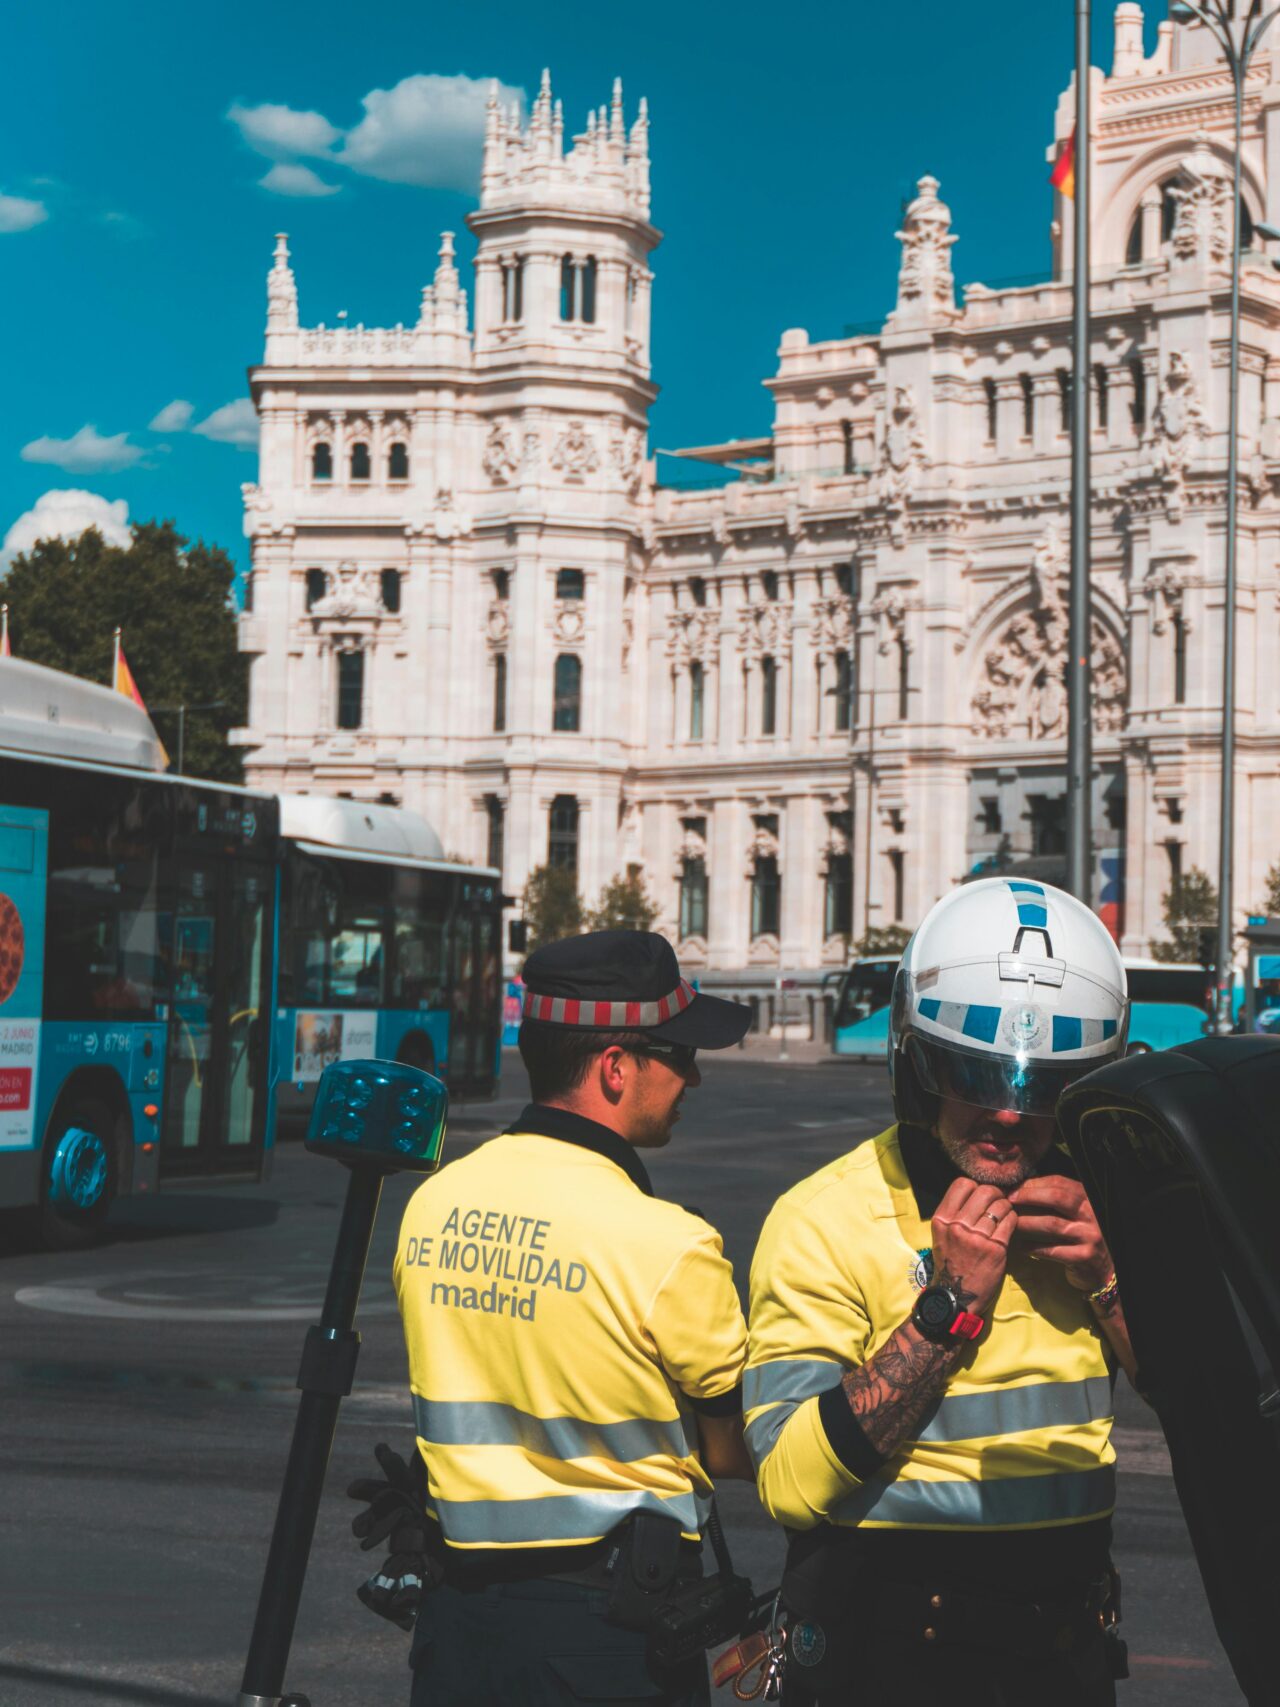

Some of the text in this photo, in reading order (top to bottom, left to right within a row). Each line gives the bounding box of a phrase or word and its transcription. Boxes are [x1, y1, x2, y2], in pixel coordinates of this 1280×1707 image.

[441, 1207, 551, 1250] AGENTE
[406, 1237, 587, 1293] DE MOVILIDAD
[430, 1282, 537, 1321] madrid
